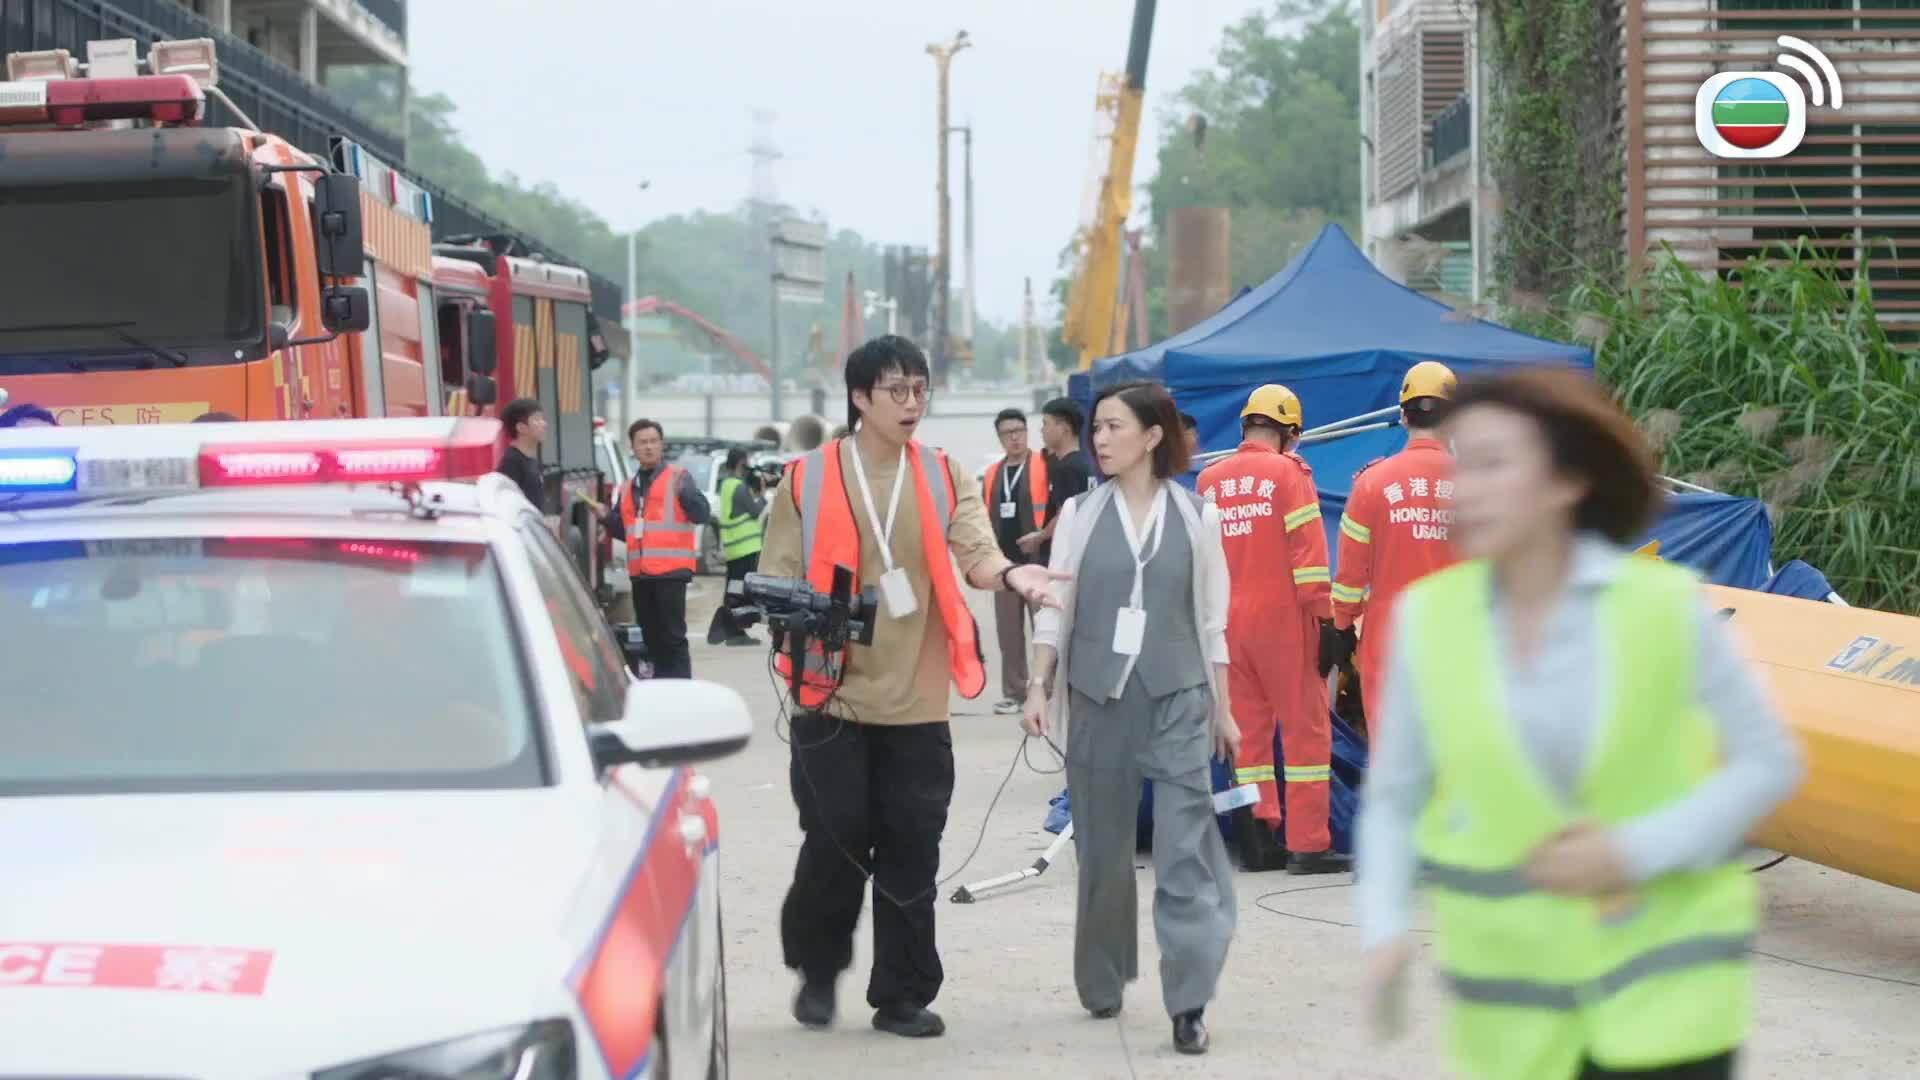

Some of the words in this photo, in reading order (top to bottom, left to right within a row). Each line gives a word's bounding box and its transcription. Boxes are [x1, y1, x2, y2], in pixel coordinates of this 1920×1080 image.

[1237, 502, 1272, 519] KONG
[1389, 507, 1430, 523] HONG
[1412, 524, 1448, 540] USAR
